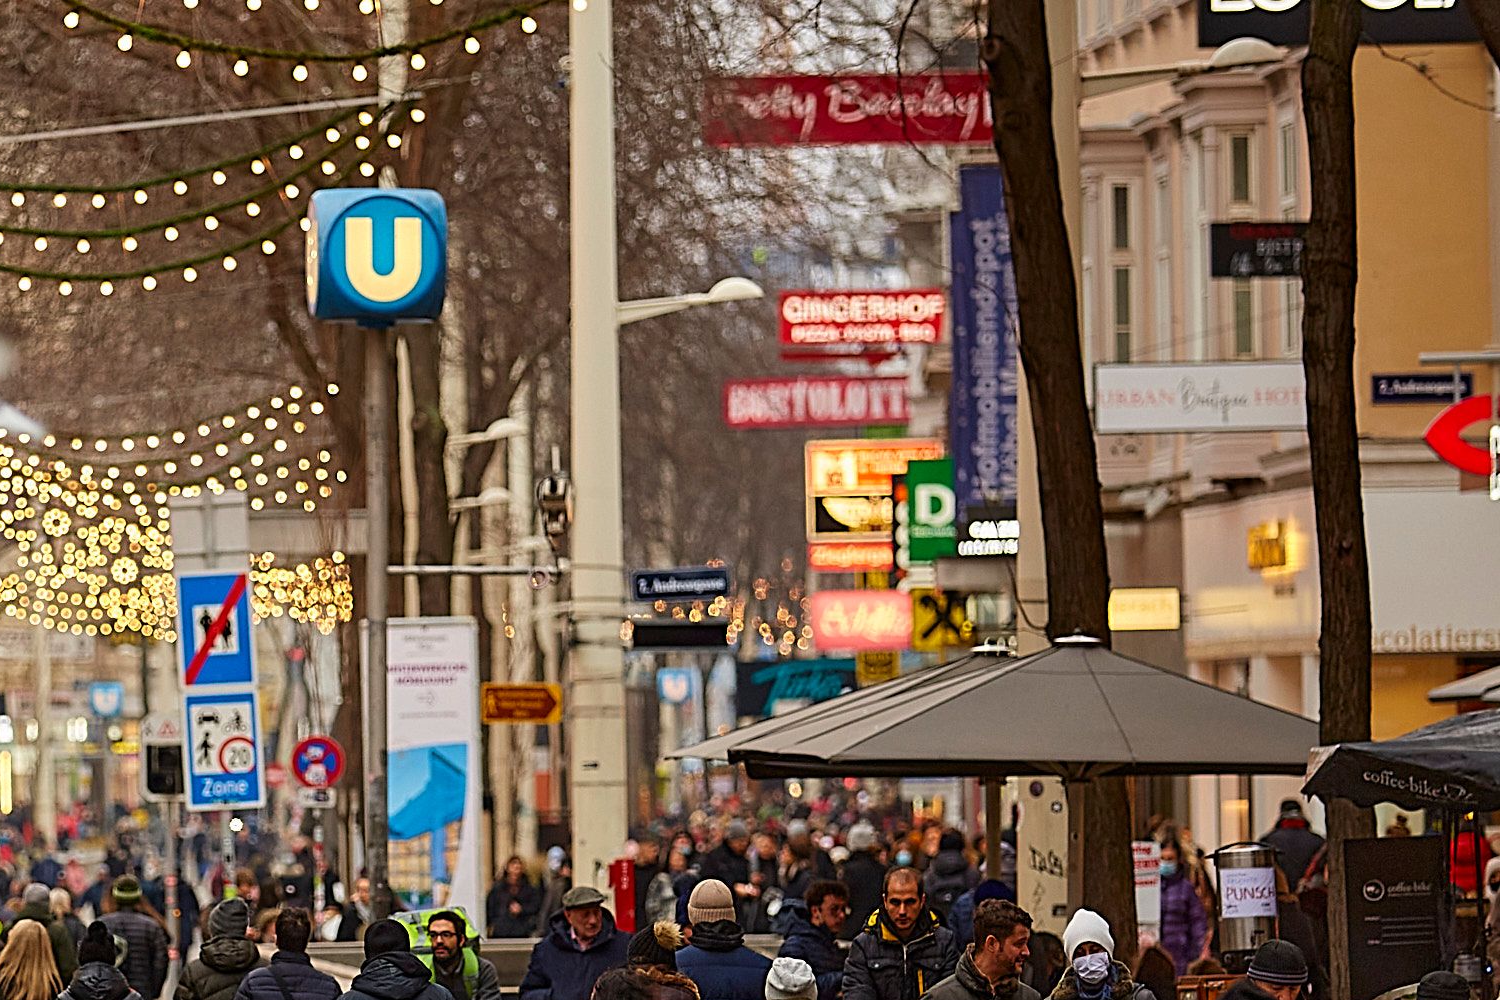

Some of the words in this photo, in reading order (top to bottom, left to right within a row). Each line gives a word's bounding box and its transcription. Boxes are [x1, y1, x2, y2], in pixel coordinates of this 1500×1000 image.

[345, 217, 422, 302] U
[915, 483, 956, 527] D
[201, 777, 250, 798] Zone
[1226, 886, 1275, 901] PUNSCH
